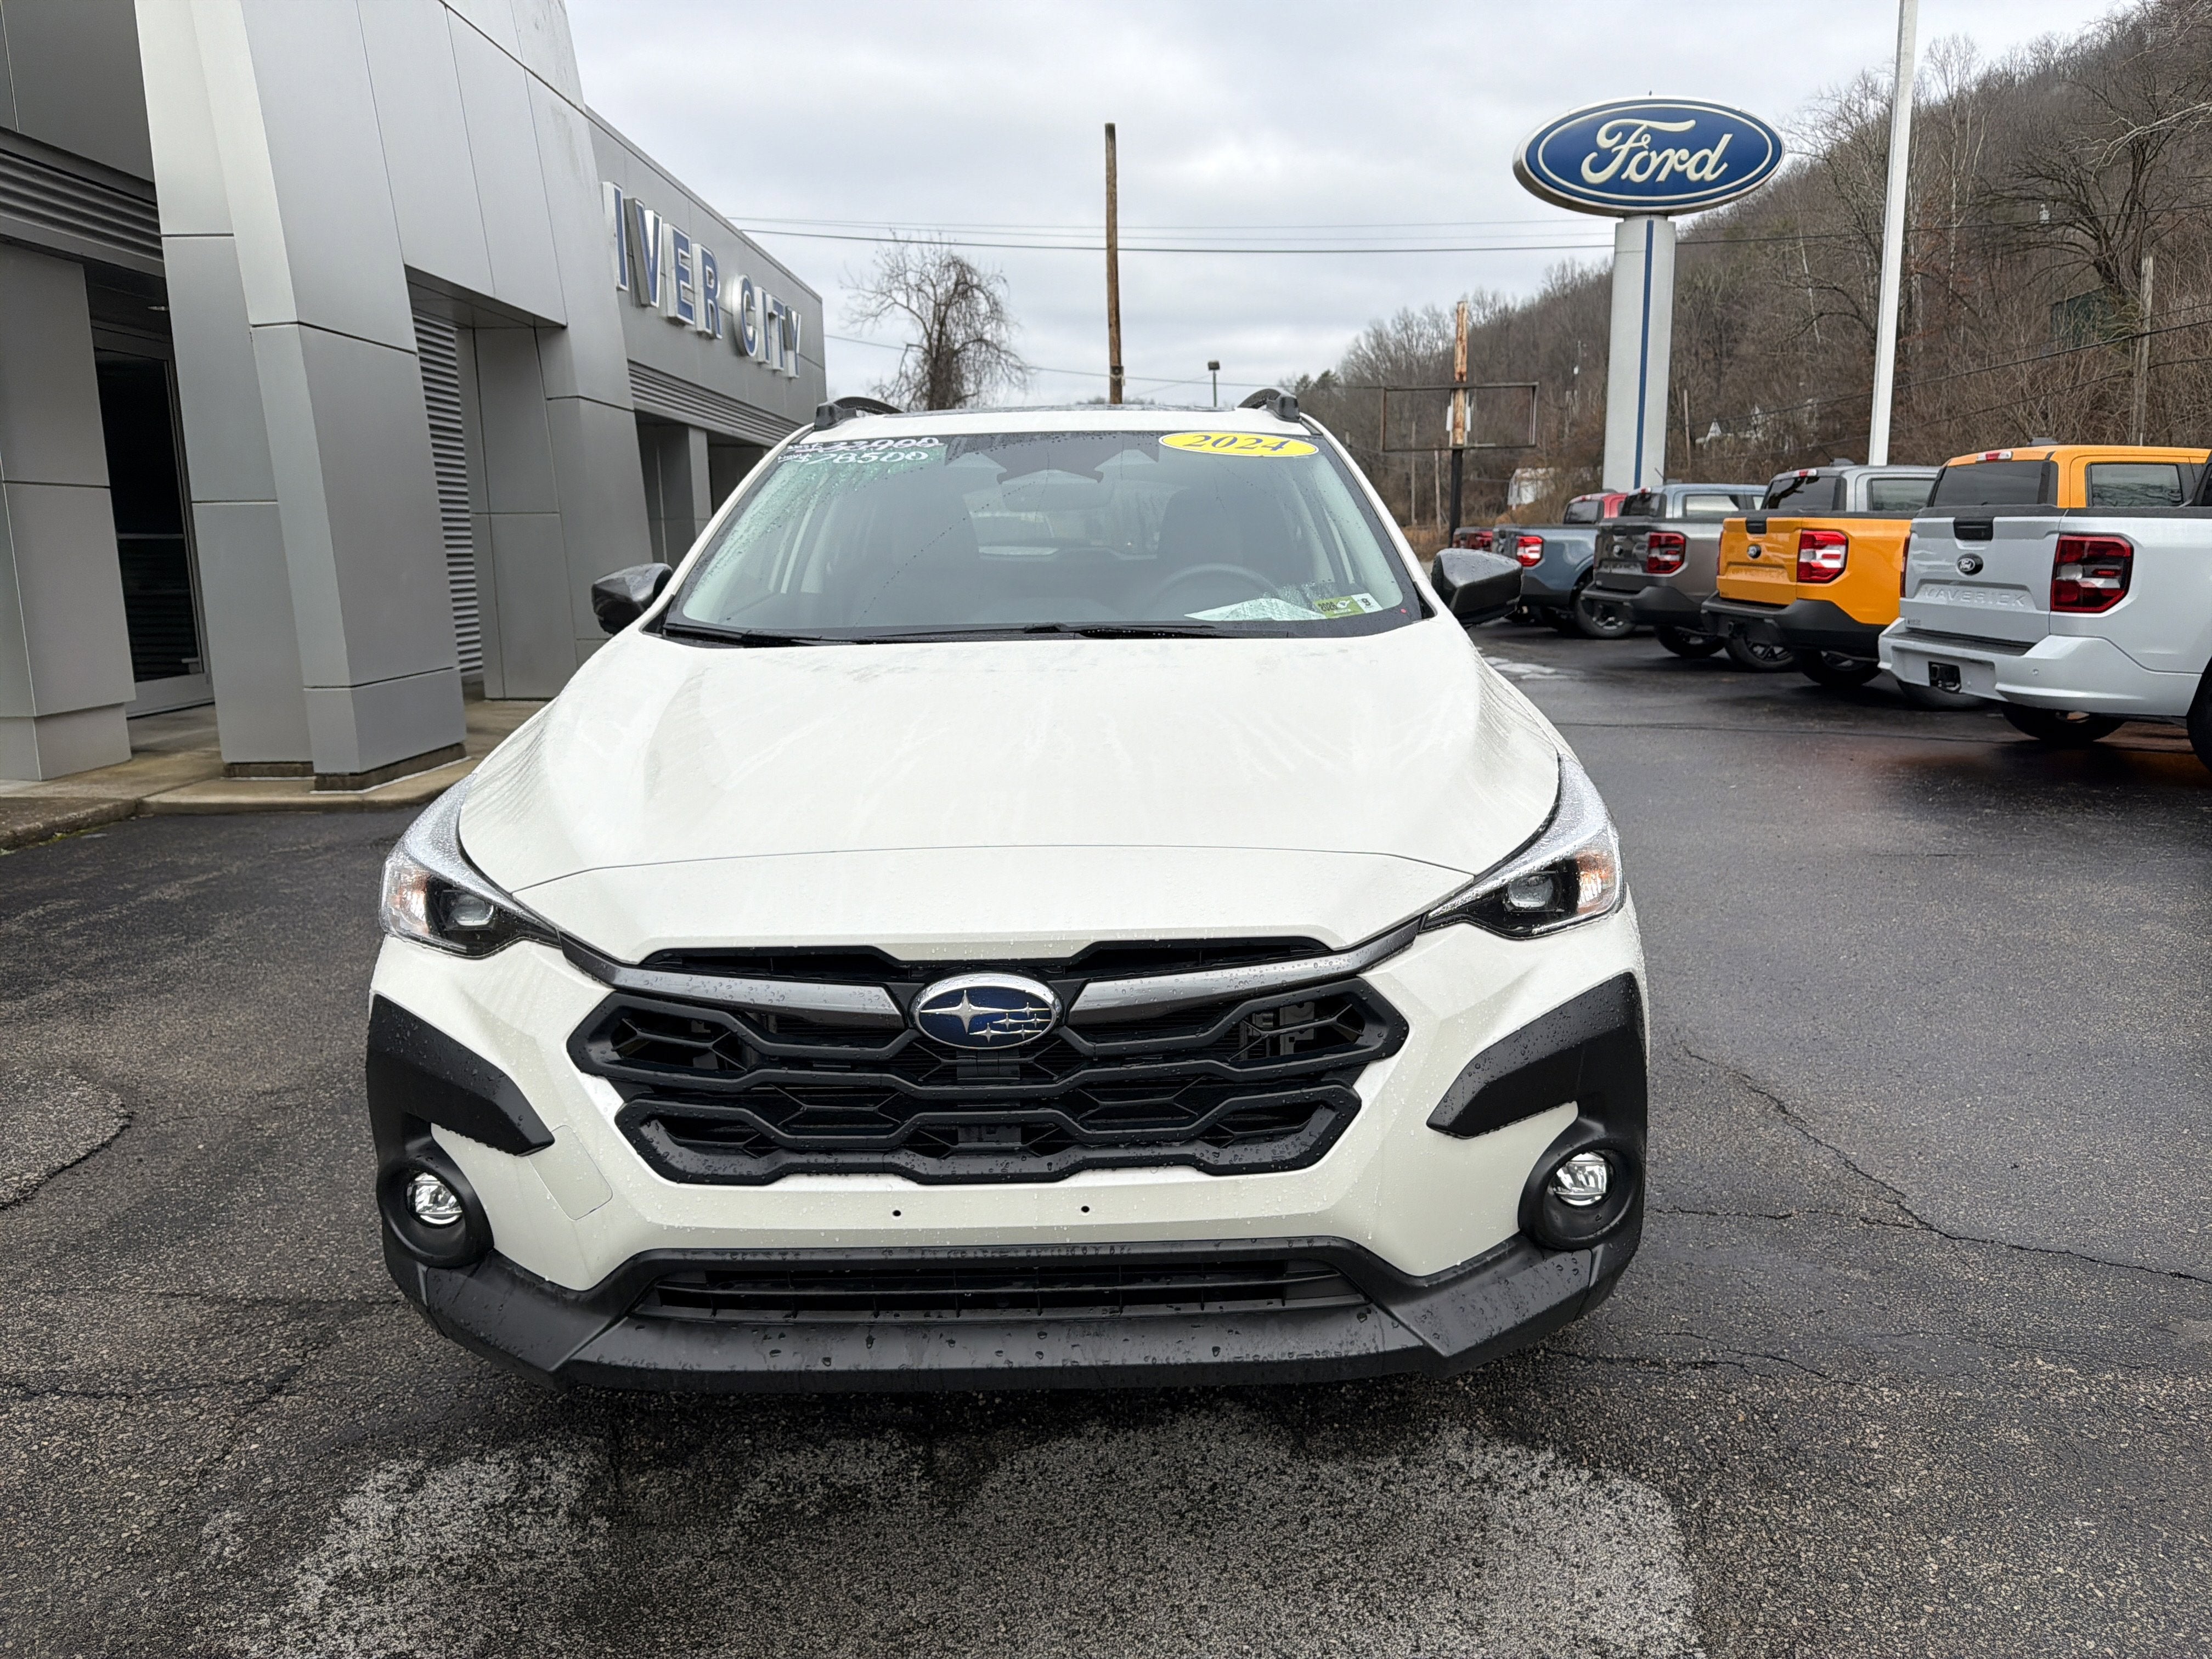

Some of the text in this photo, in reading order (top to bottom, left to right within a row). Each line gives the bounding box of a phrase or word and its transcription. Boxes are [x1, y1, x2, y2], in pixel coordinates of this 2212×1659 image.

[1580, 118, 1733, 184] Ford
[732, 274, 801, 379] CITY
[1182, 435, 1291, 452] 2024
